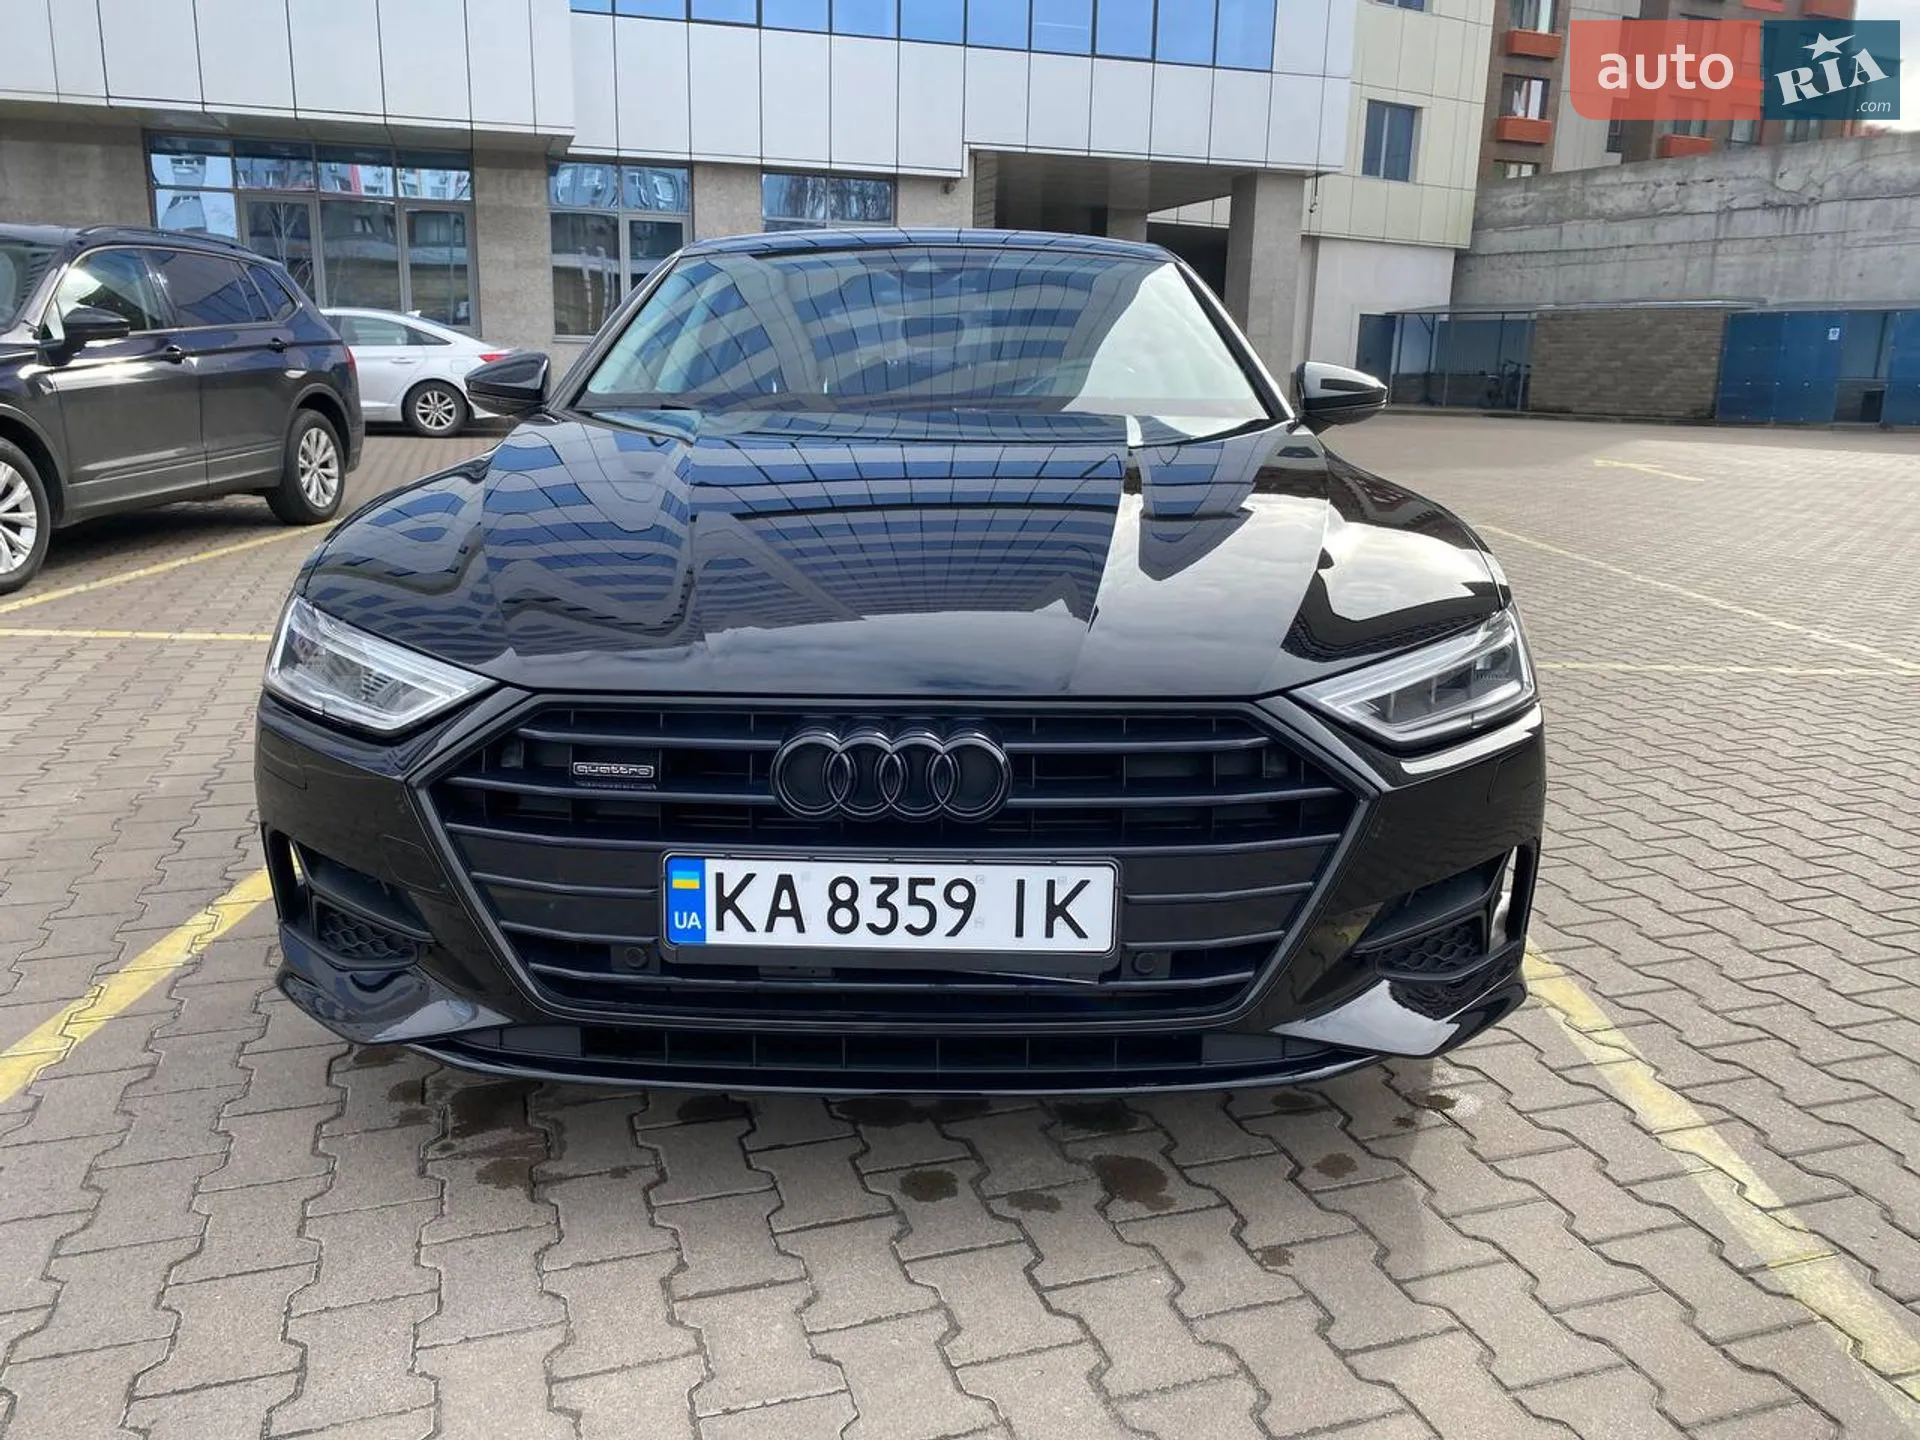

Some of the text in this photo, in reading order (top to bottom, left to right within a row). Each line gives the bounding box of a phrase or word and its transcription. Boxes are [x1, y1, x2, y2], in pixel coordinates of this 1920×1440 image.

[576, 764, 650, 776] quattro
[715, 872, 1091, 939] KA 8359 IK
[674, 911, 702, 930] UA
